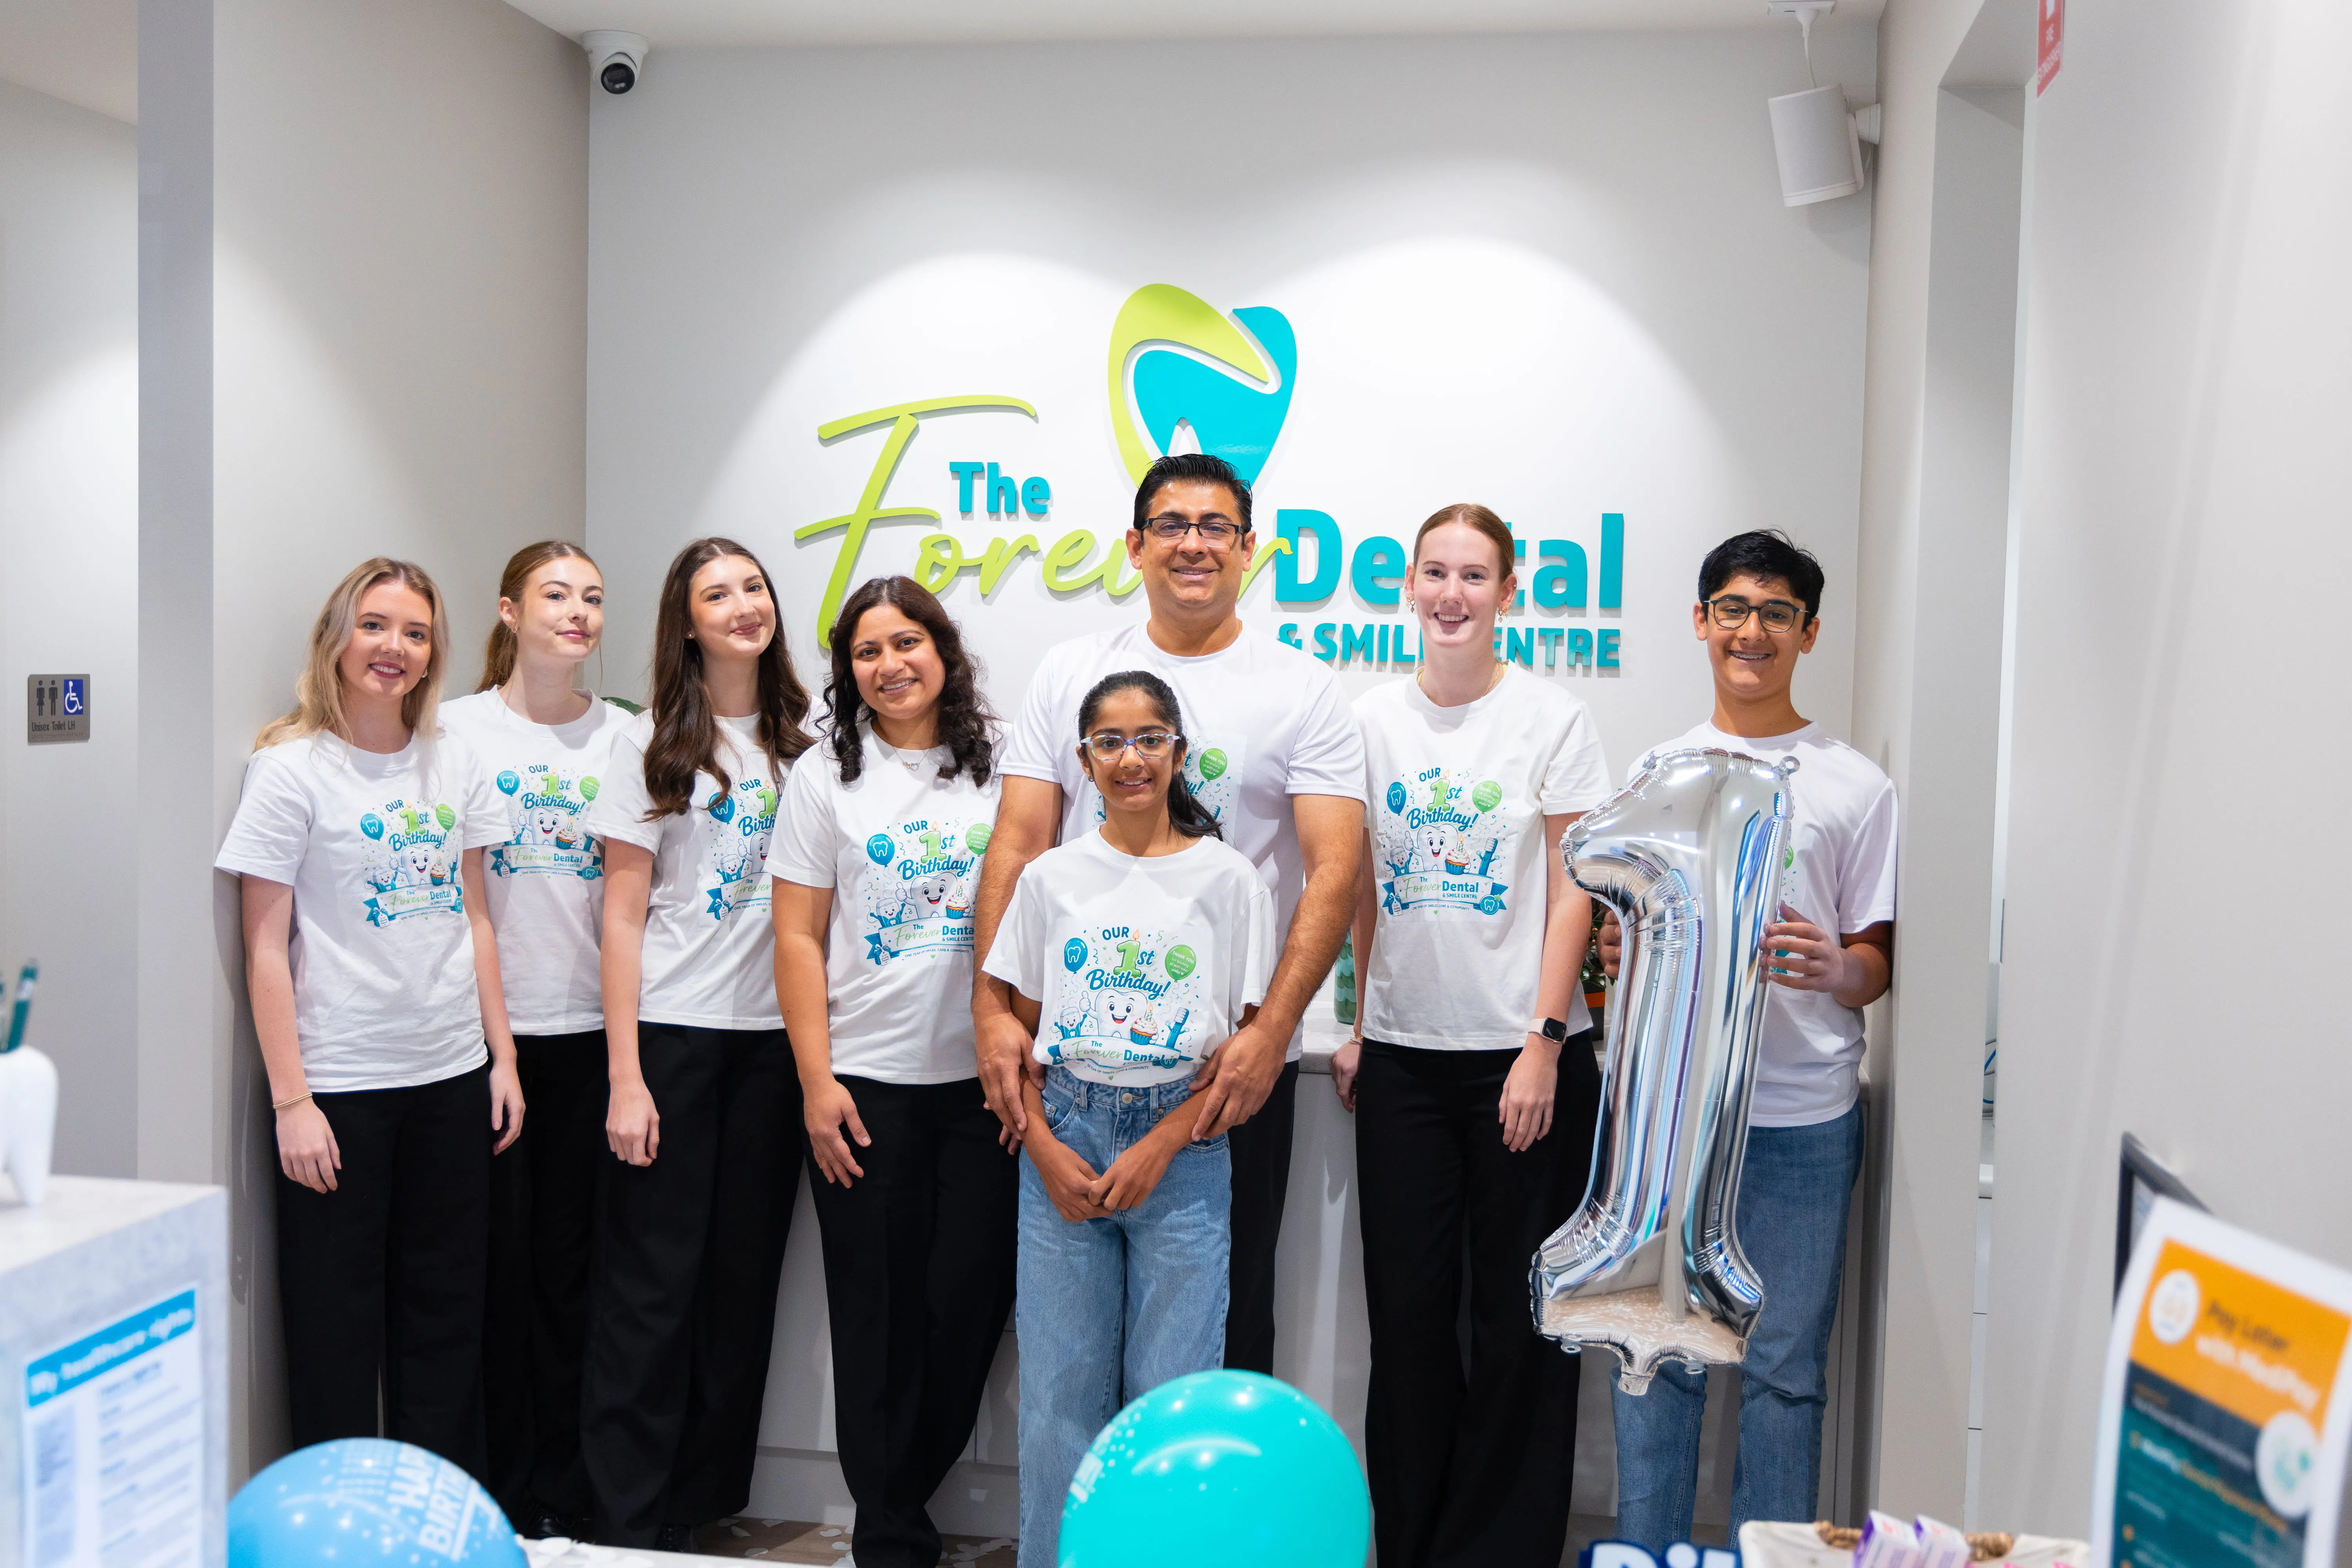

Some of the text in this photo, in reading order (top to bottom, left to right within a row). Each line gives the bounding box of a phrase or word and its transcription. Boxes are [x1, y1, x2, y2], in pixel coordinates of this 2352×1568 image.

[949, 462, 1050, 514] The
[794, 395, 1624, 649] Forevr Deal
[1313, 623, 1423, 663] SMIL
[31, 720, 75, 732] Unisex Toilet LH
[529, 765, 548, 773] OUR
[1419, 767, 1441, 782] OUR
[541, 773, 572, 799] 1st
[740, 779, 762, 791] OUR
[1427, 779, 1462, 811] 1st
[385, 799, 404, 812] OUR
[521, 792, 586, 815] Birthday!
[399, 808, 430, 835] 1st
[738, 813, 775, 837] Birth
[904, 820, 928, 834] OUR
[1406, 806, 1479, 831] Birthday!
[388, 830, 447, 851] Birthday!
[919, 831, 955, 863] 1st
[513, 847, 583, 864] Forever Dental
[897, 855, 975, 880] Birthday!
[734, 879, 771, 902] Frever
[1403, 877, 1479, 898] Forever Dental
[388, 889, 452, 911] Forever Dental
[893, 925, 974, 947] Forever Denta
[1102, 927, 1129, 940] OUR
[1114, 940, 1154, 977] 1st
[1173, 951, 1185, 959] THANK
[1085, 969, 1171, 1000] Birthday!
[1071, 1040, 1123, 1059] Forever
